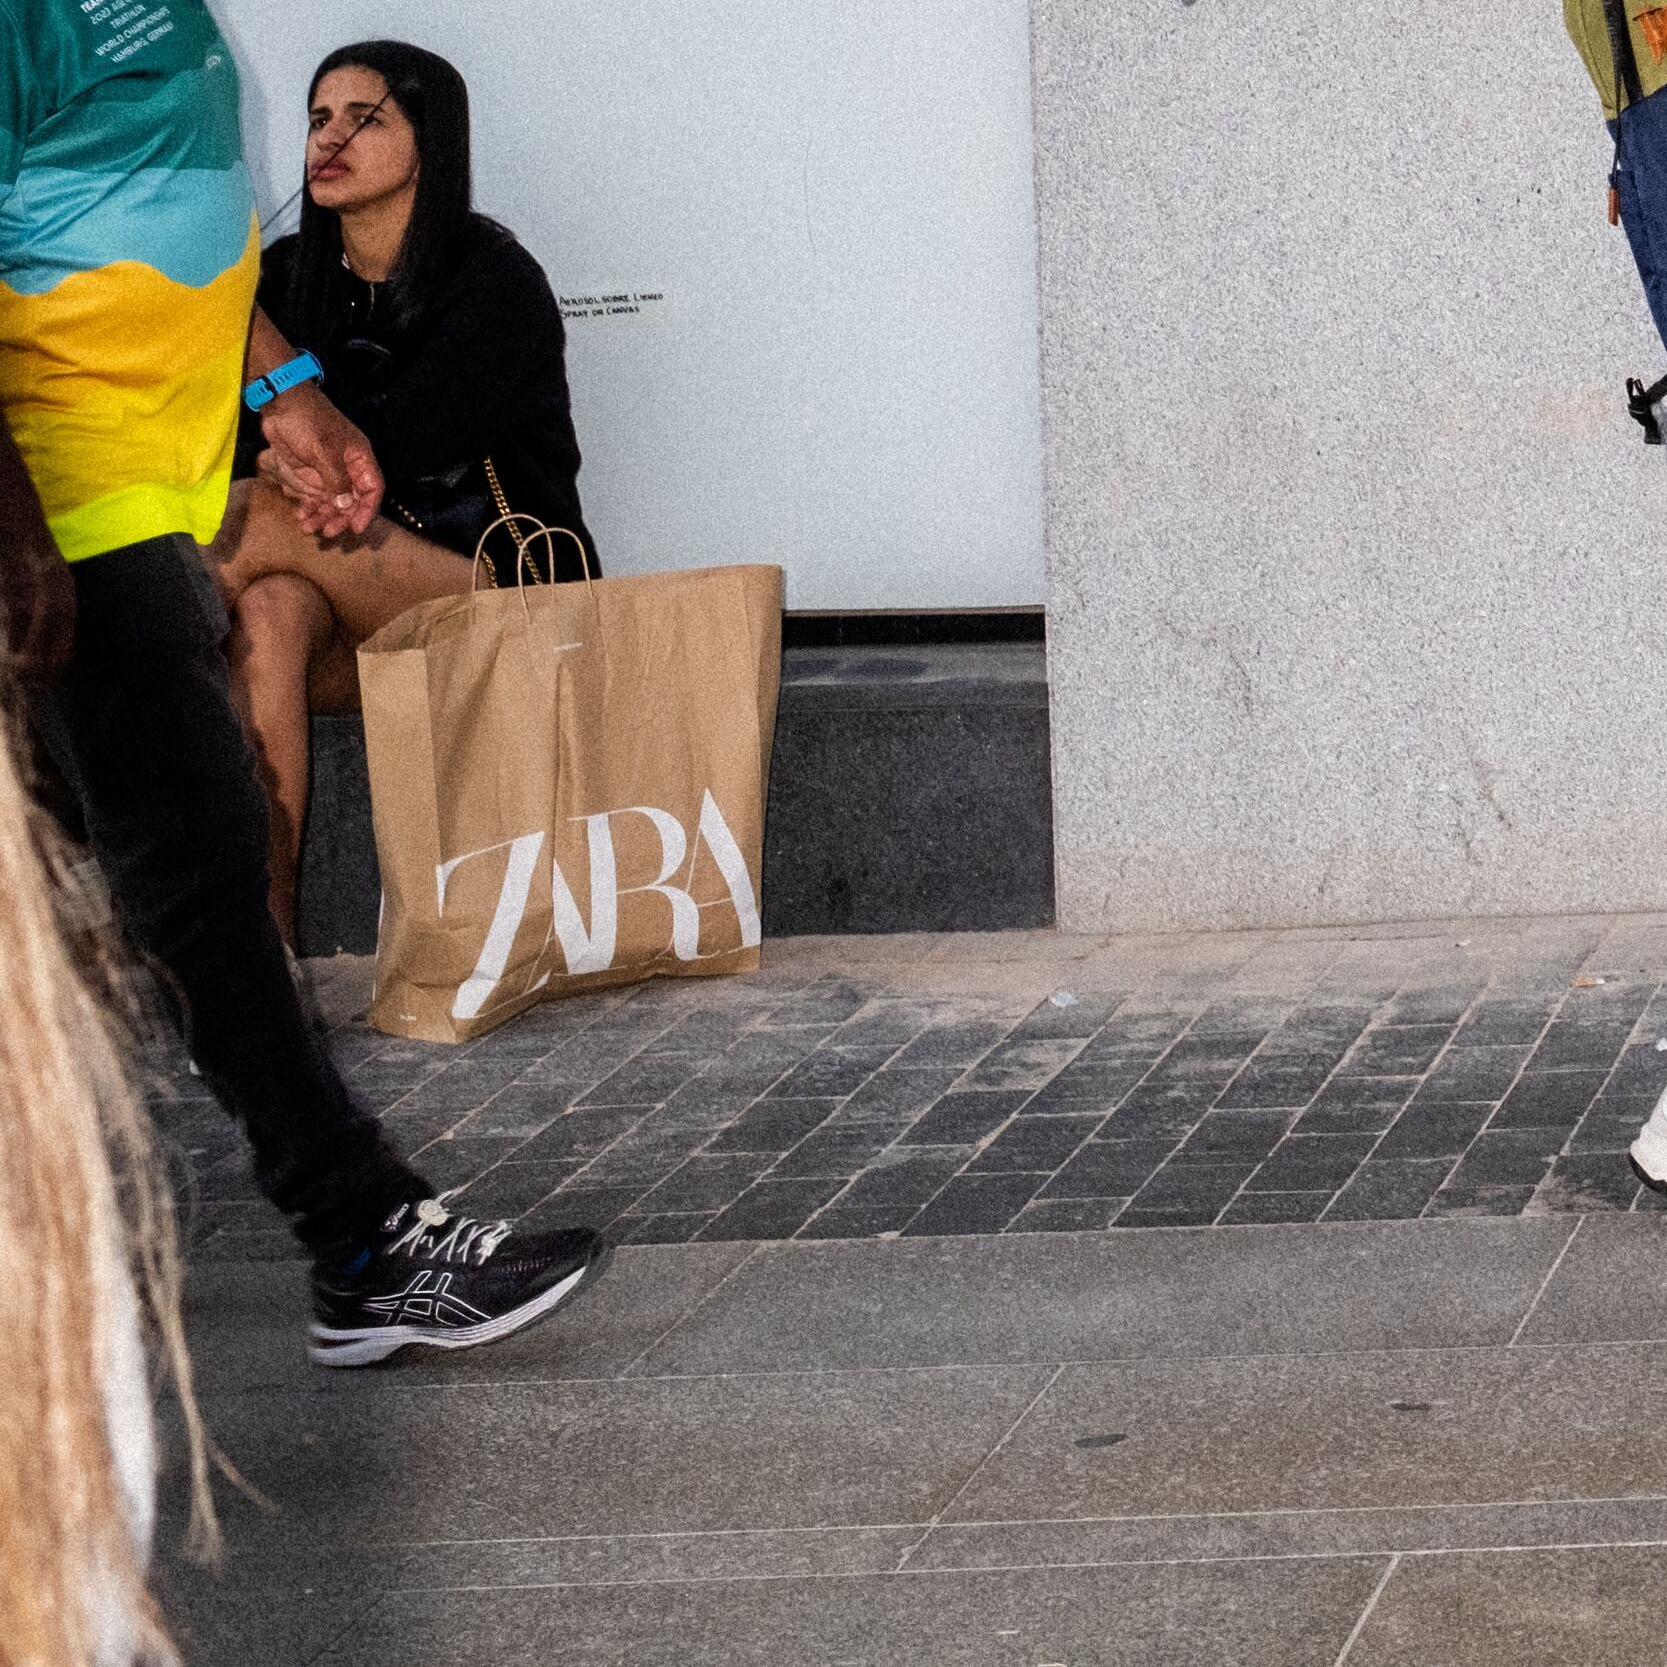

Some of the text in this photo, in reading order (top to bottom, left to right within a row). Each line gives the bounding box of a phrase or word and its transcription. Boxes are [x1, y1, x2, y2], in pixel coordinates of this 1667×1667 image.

[95, 34, 125, 56] WORLD
[560, 296, 601, 307] AEROSOL
[602, 295, 630, 304] SOBRE
[560, 306, 640, 320] SPRAY ON CANVAS
[435, 788, 762, 1020] ZARA
